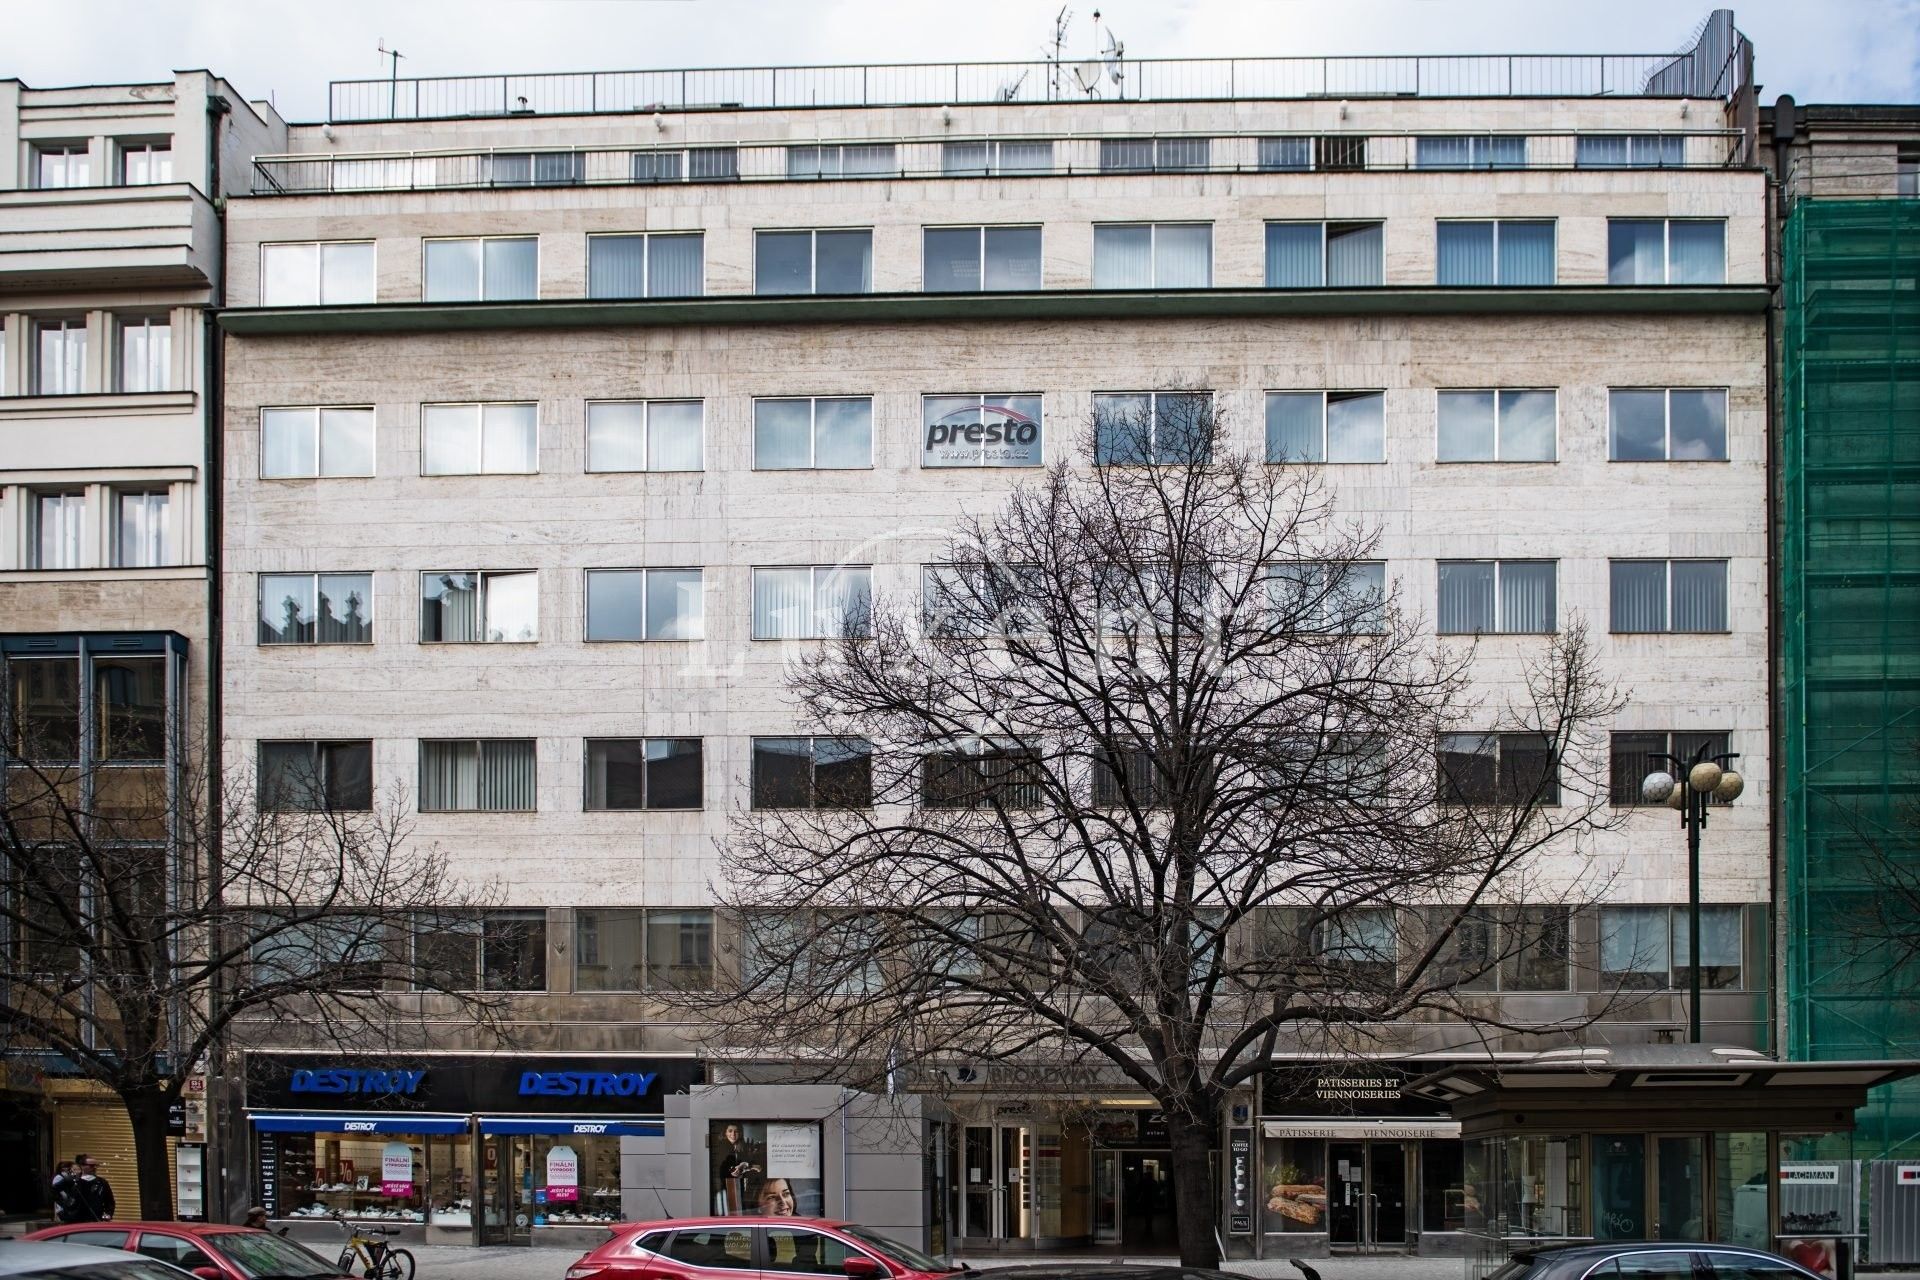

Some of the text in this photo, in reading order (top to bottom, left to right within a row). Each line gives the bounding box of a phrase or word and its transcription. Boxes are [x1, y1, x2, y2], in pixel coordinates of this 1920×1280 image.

[925, 418, 1038, 451] presto
[990, 1067, 1103, 1084] BROADWAY
[290, 1068, 427, 1094] DESTROY
[518, 1071, 658, 1096] DESTROY
[1385, 1078, 1400, 1087] ET
[1316, 1090, 1401, 1099] VIENNOISERIES
[344, 1122, 377, 1131] DESTROY
[573, 1124, 607, 1133] DESTROY
[1363, 1129, 1435, 1138] VIENNOISERIE
[1789, 1171, 1832, 1179] LACHMAN
